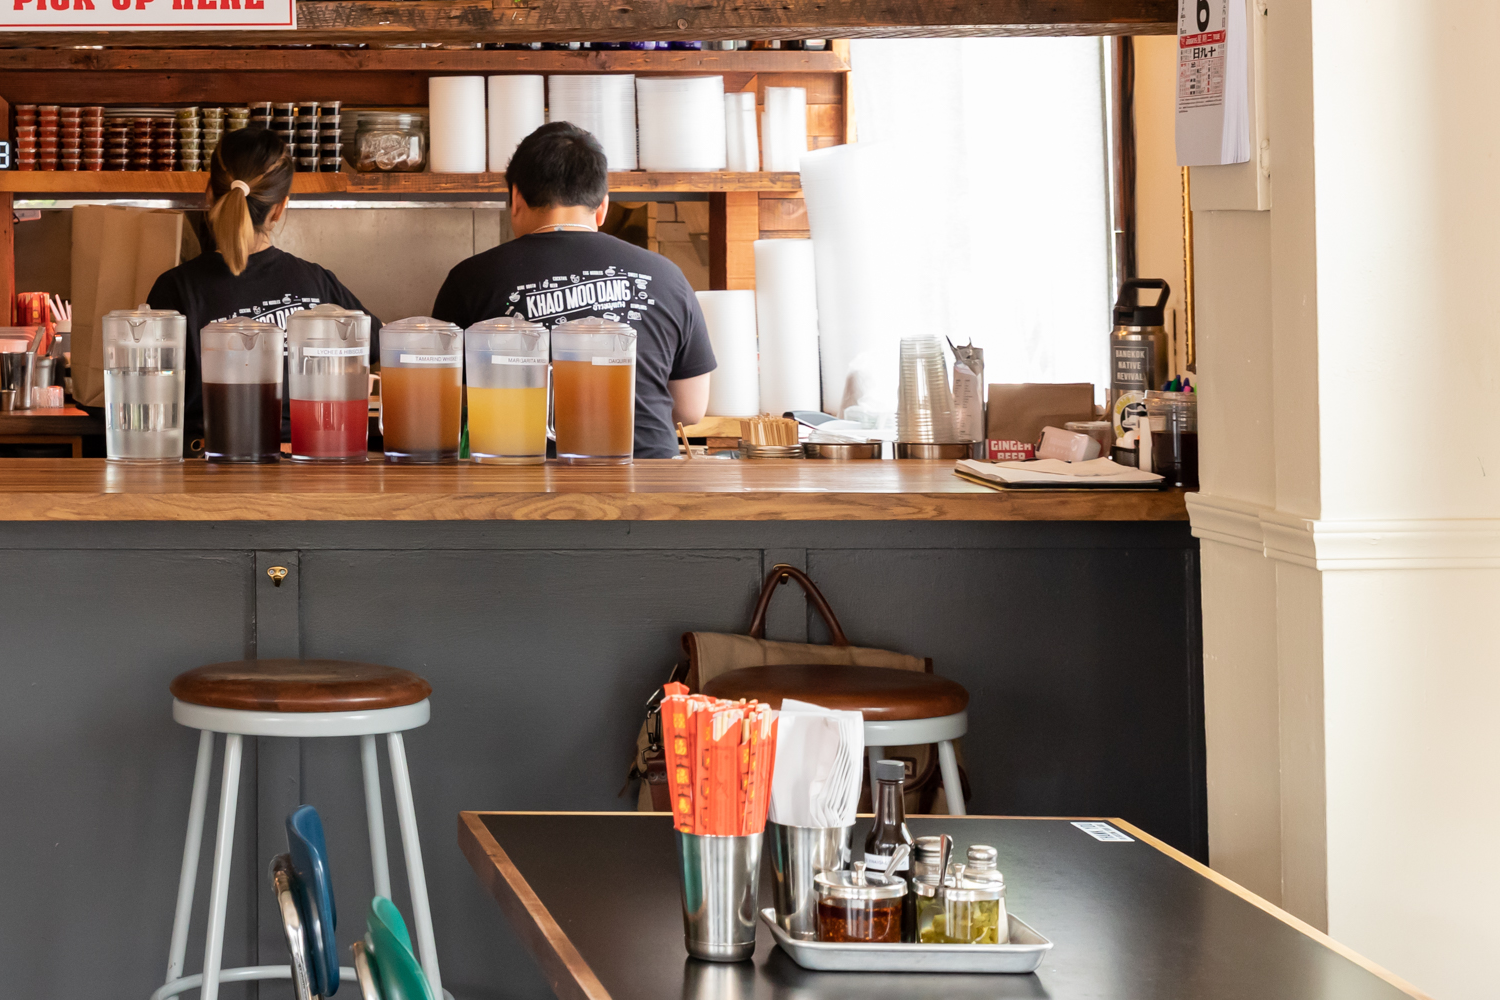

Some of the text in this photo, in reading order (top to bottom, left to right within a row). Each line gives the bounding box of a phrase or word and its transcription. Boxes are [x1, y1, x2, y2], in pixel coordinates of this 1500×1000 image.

[526, 280, 631, 318] KHAO MOO DANG
[1116, 350, 1145, 358] BANGKOK
[1117, 372, 1143, 380] REVIVAL
